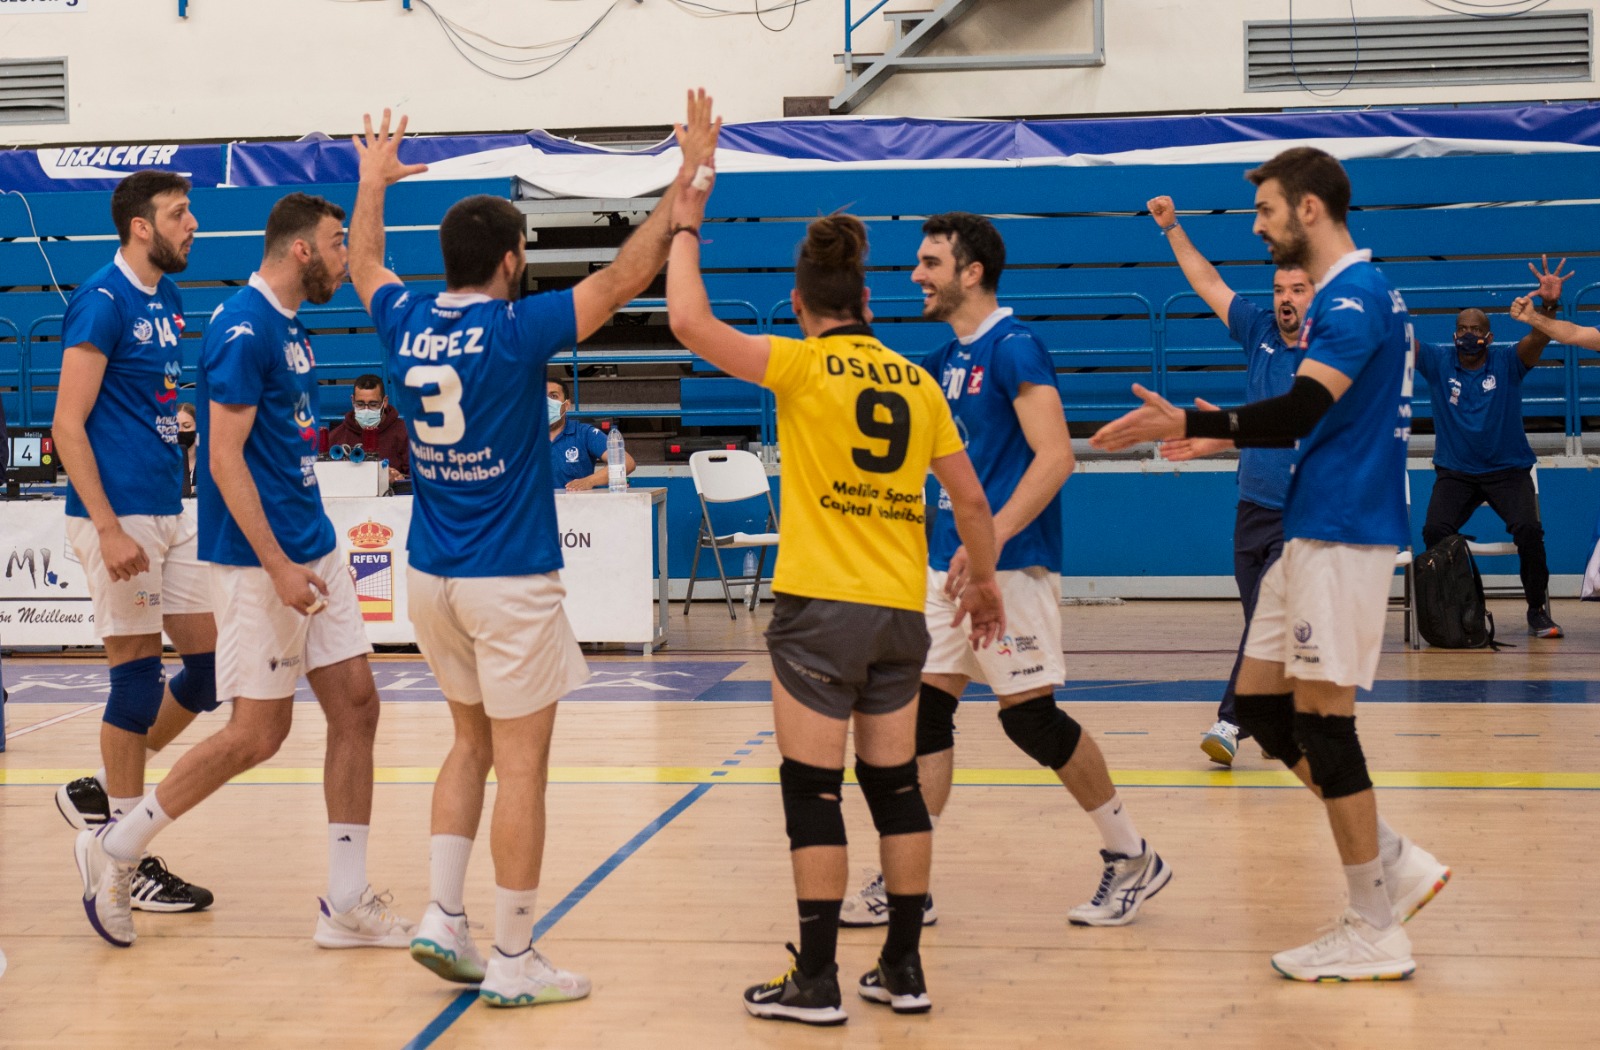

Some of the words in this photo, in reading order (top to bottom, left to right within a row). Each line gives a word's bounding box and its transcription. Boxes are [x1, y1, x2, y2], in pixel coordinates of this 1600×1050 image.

[56, 145, 179, 167] TRACKER
[155, 317, 177, 347] 14
[398, 327, 484, 360] LÓPEZ
[826, 354, 921, 386] OSADO
[404, 364, 466, 445] 3
[851, 387, 910, 474] 9
[22, 444, 32, 461] 4
[45, 441, 50, 451] 1
[448, 446, 492, 467] Sport
[439, 459, 505, 481] Voleibol
[353, 555, 388, 563] RFEVB
[18, 607, 83, 623] Melillense
